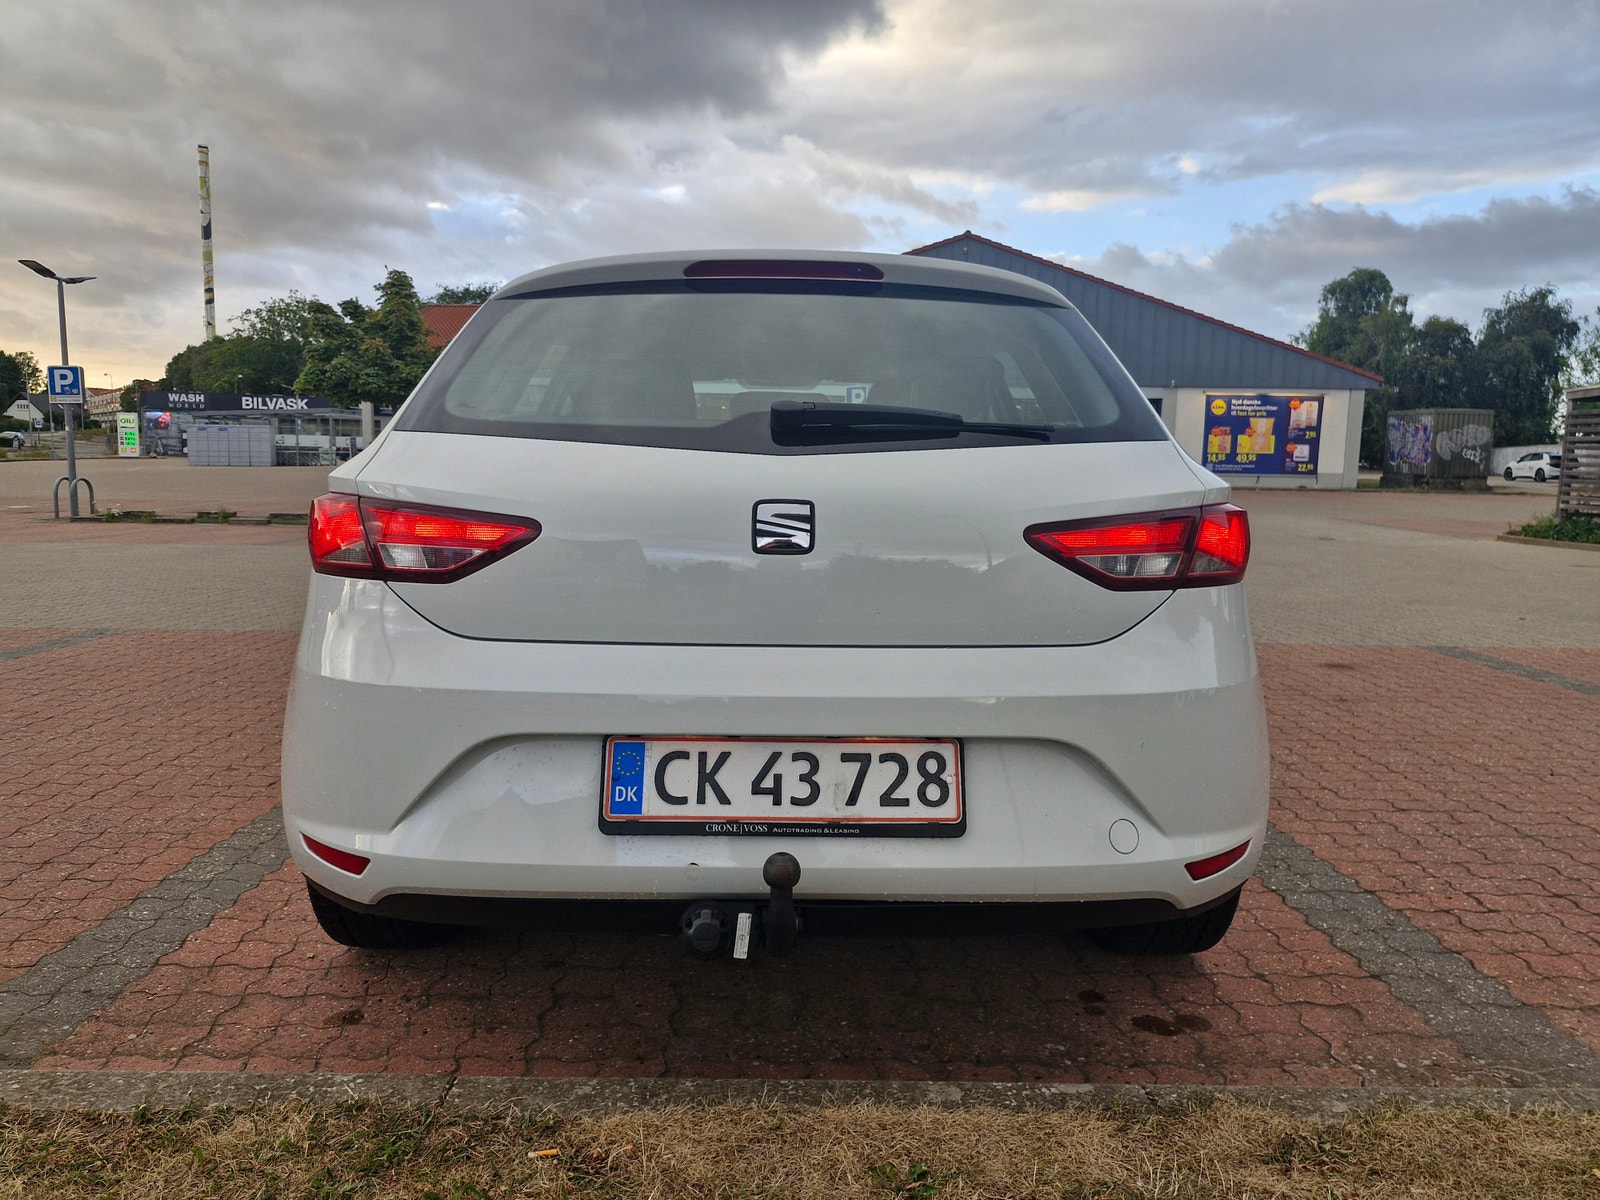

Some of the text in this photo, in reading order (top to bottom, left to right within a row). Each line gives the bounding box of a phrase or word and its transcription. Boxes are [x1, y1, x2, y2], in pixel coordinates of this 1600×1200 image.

[54, 369, 73, 393] P
[168, 392, 205, 403] WASH
[241, 396, 309, 410] BILVASK
[653, 750, 950, 807] CK 43 728
[614, 786, 638, 803] DK
